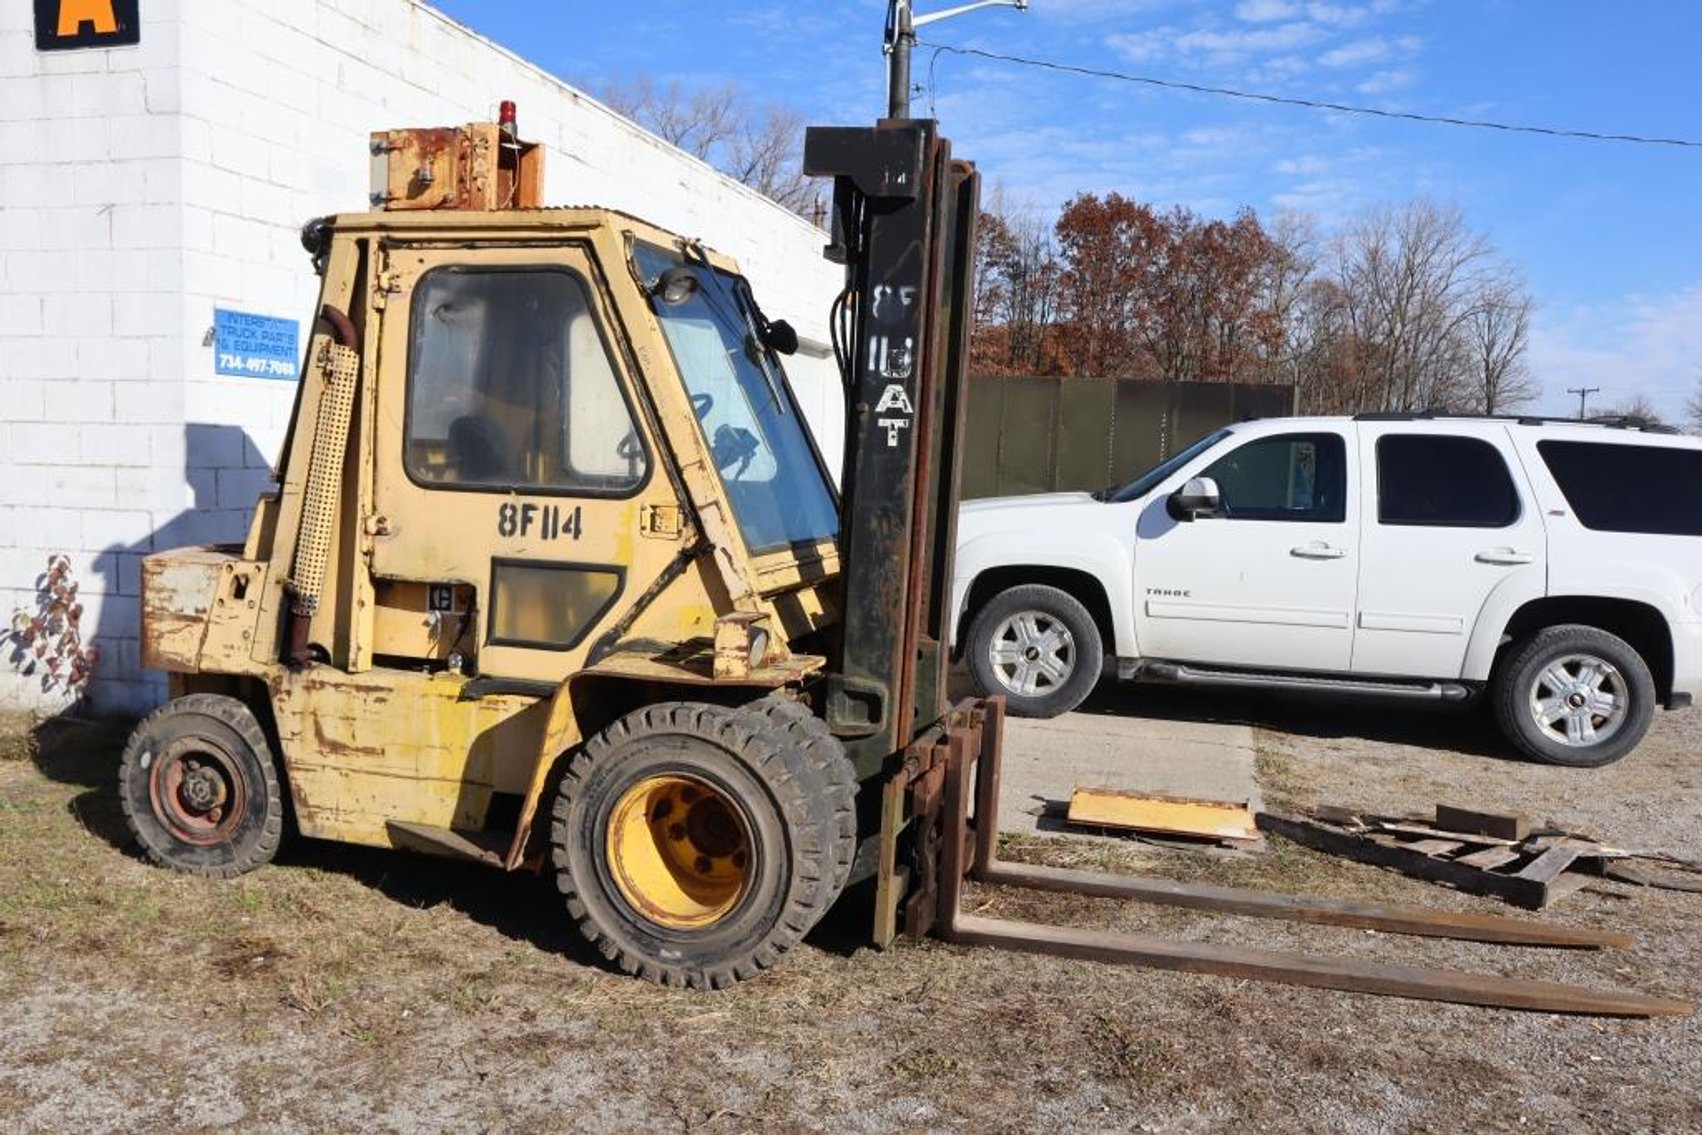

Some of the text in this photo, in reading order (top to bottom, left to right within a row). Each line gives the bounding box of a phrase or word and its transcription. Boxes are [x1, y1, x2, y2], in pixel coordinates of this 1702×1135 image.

[220, 324, 257, 340] TRUCK
[498, 502, 582, 540] 8F114
[1146, 588, 1192, 598] TAHOE
